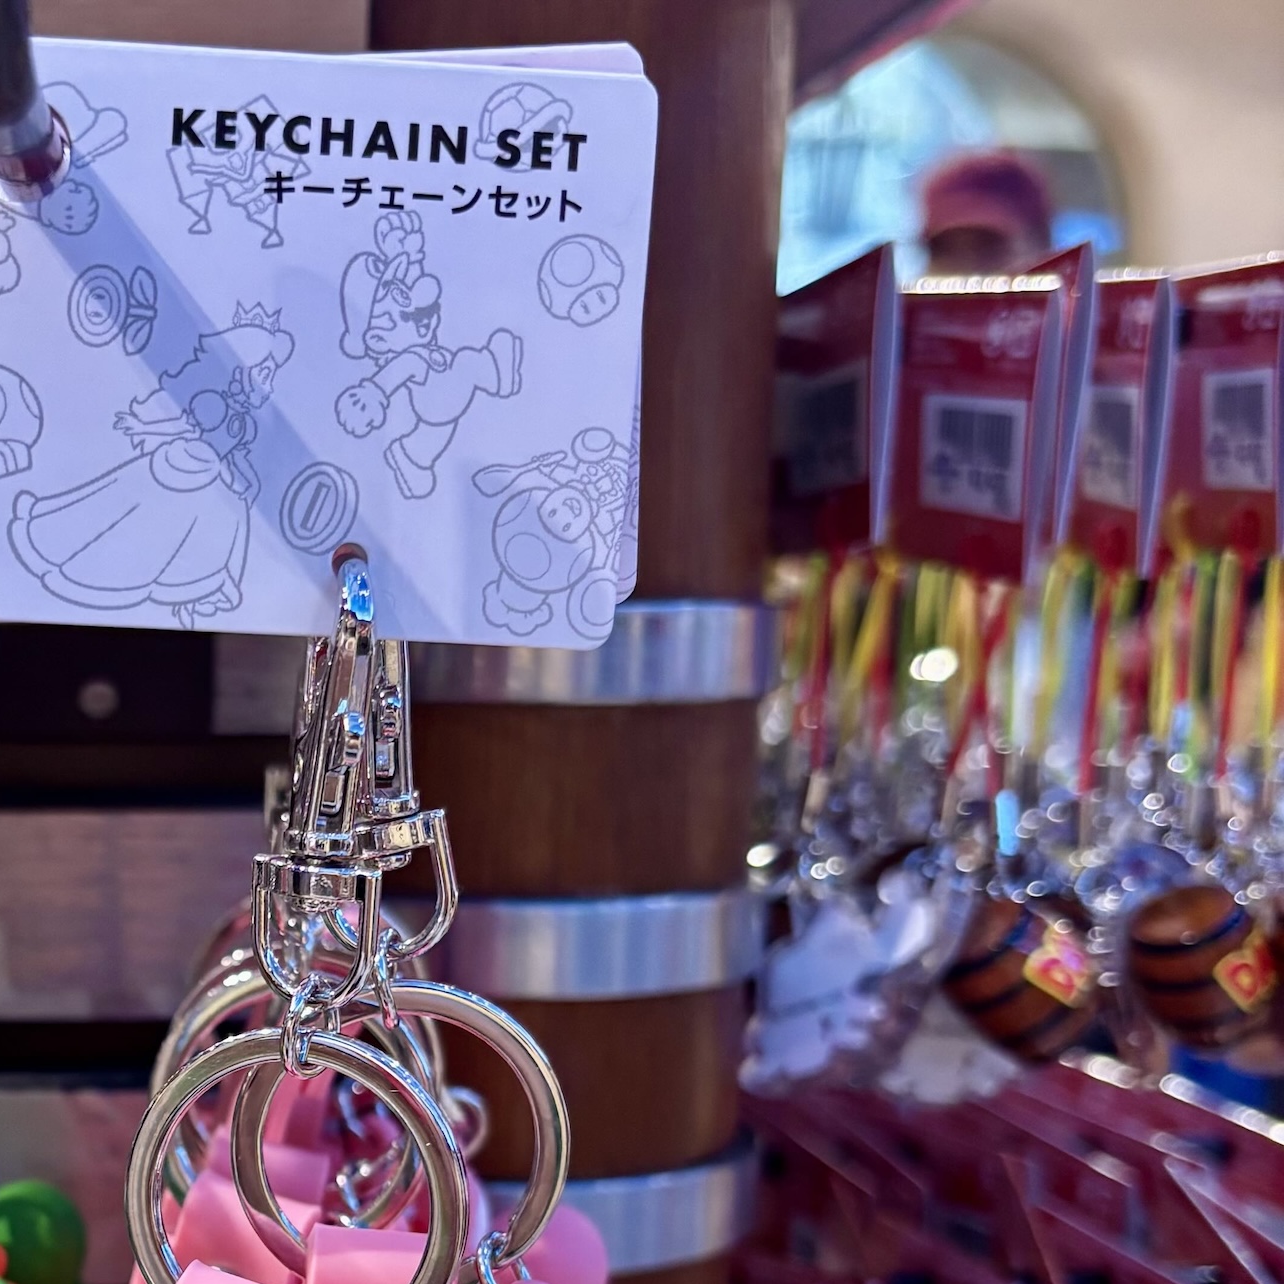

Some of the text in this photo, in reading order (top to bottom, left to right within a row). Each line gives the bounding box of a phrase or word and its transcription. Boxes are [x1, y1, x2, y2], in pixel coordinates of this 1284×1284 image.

[171, 108, 588, 172] KEYCHAIN SET
[263, 171, 583, 222] キーチェーンセット
